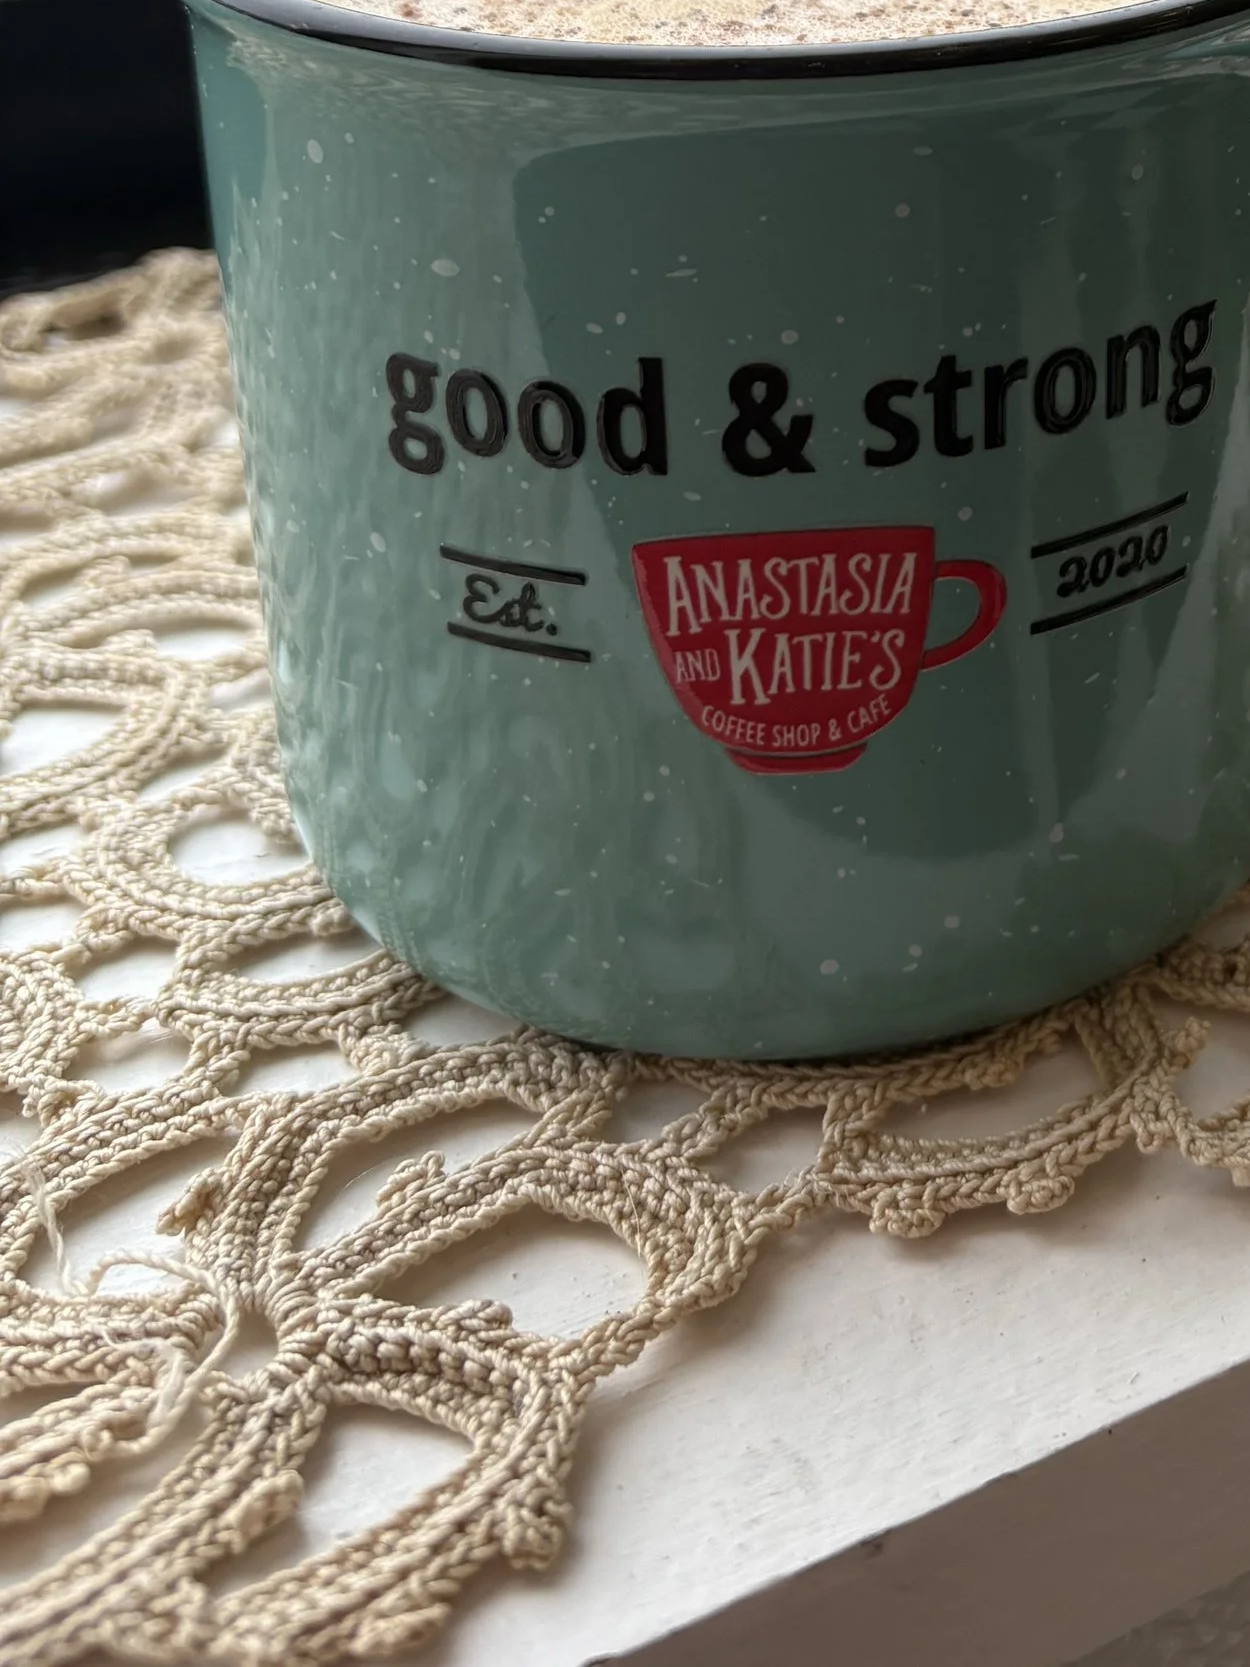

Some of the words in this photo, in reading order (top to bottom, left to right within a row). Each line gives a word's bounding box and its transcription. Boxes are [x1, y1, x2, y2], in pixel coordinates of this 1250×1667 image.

[386, 351, 667, 477] good
[721, 361, 816, 478] &
[862, 298, 1218, 469] strong
[663, 552, 918, 637] ANASTASIA
[1056, 524, 1170, 598] 2020
[463, 573, 558, 636] Est.
[675, 647, 722, 683] AND
[724, 627, 906, 705] KATIE'S
[702, 704, 766, 746] COFFEE
[771, 722, 822, 748] SHOP
[827, 717, 842, 742] &
[846, 693, 892, 733] CAFE
